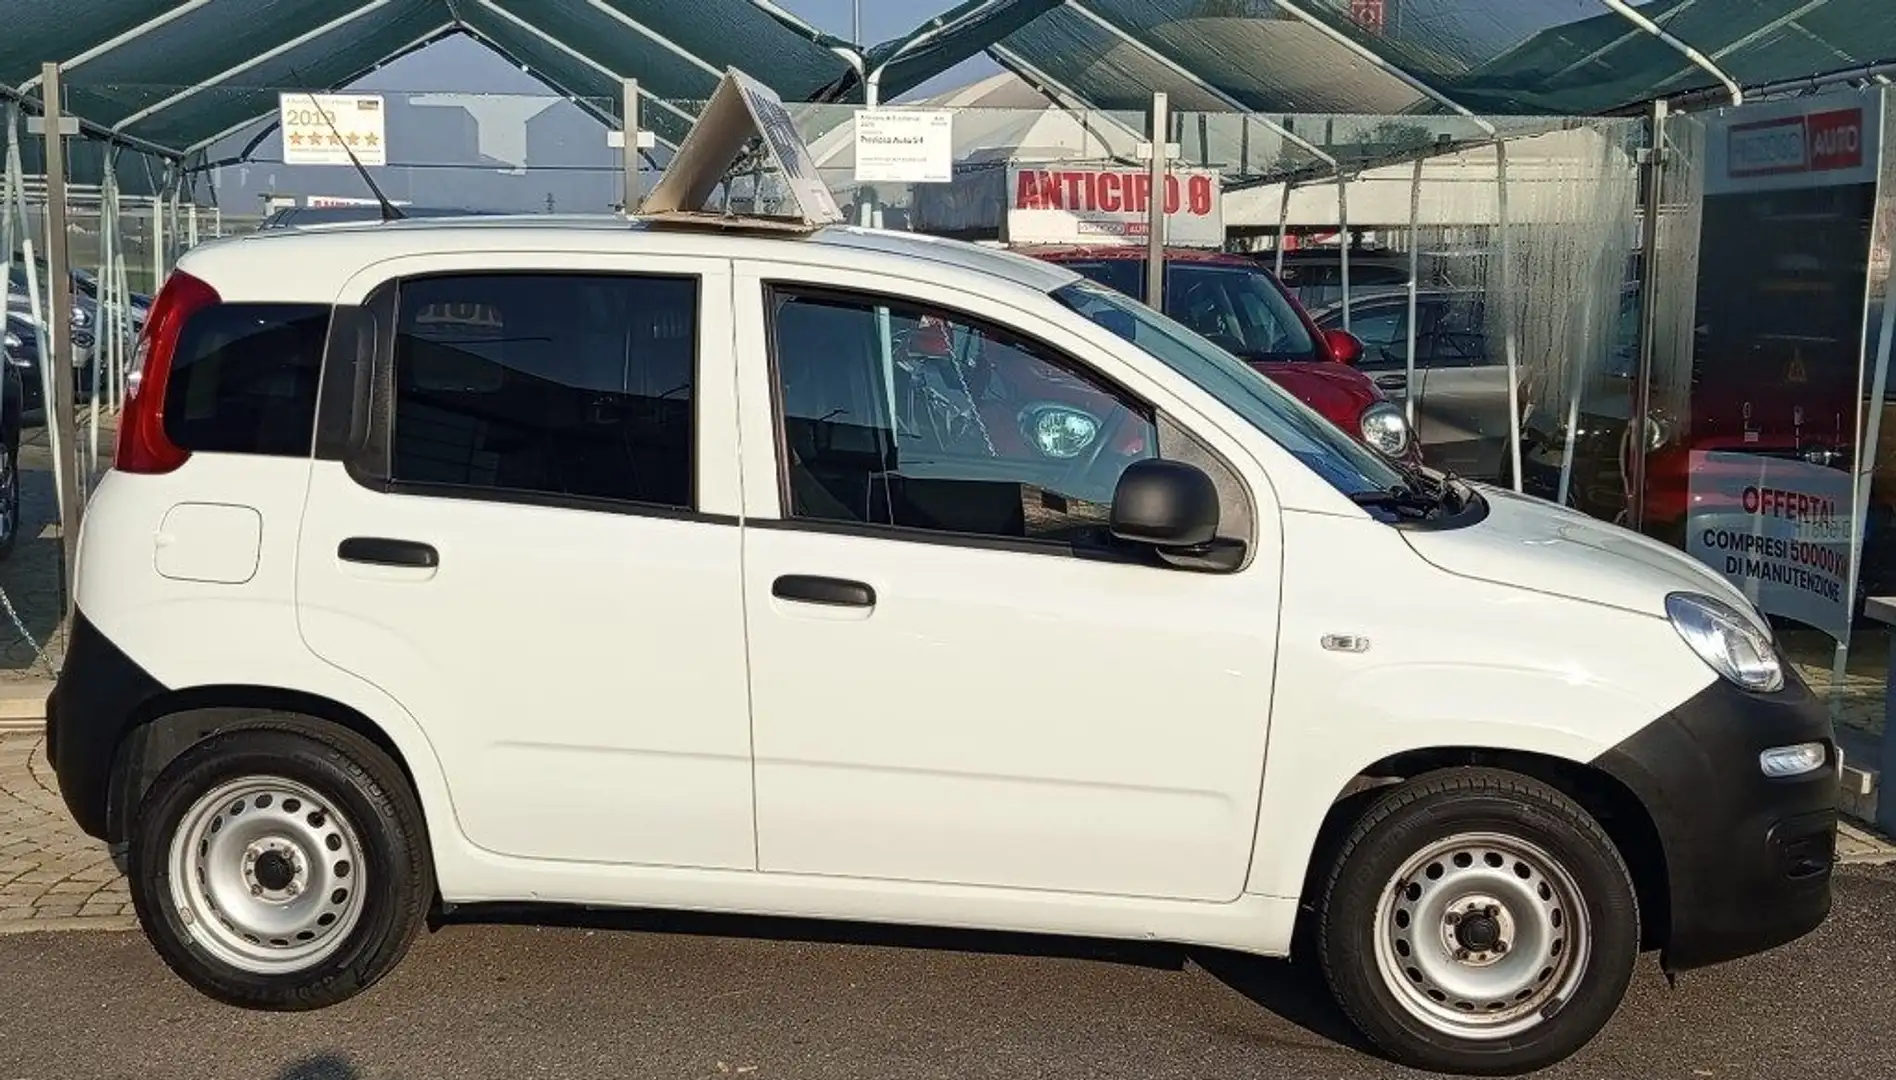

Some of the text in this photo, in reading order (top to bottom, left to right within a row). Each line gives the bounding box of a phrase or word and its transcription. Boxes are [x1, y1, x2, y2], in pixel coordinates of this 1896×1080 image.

[1812, 125, 1859, 158] AUTO
[1742, 486, 1835, 523] OFFERTA!
[1703, 529, 1788, 558] COMPRESI
[1725, 556, 1742, 575] DI
